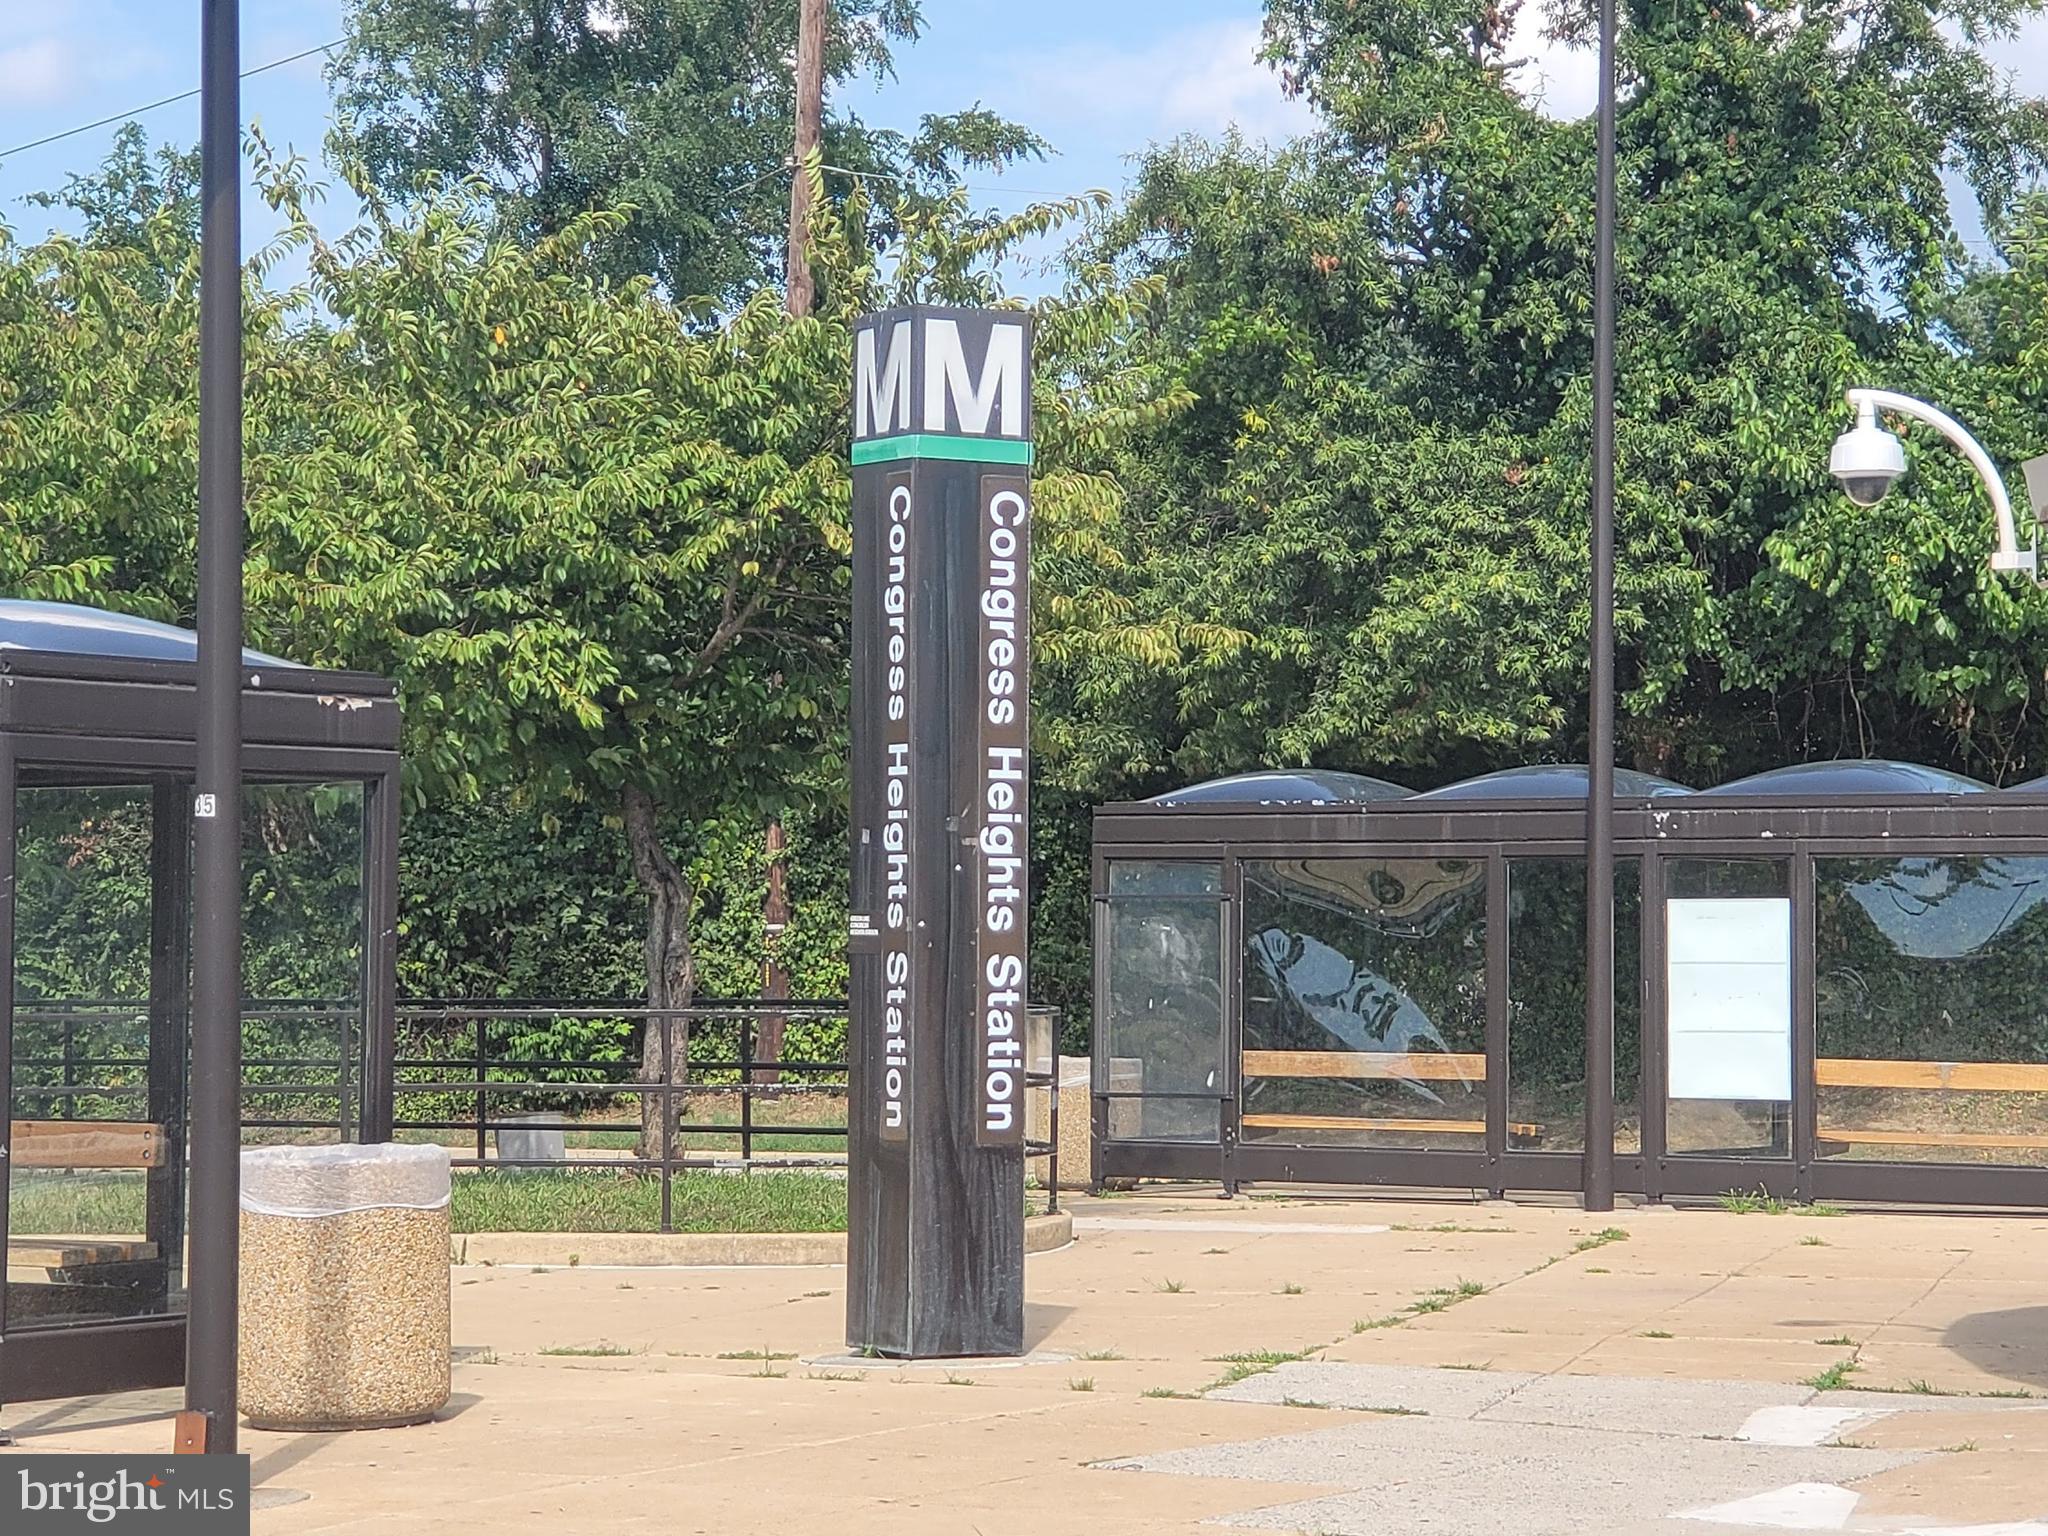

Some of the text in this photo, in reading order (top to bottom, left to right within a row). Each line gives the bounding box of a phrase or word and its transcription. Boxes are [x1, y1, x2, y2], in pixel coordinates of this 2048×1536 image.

[856, 319, 911, 437] M
[924, 318, 1023, 436] M
[883, 485, 912, 1128] Congress Heights Station
[980, 490, 1025, 1130] Congress Heights Station
